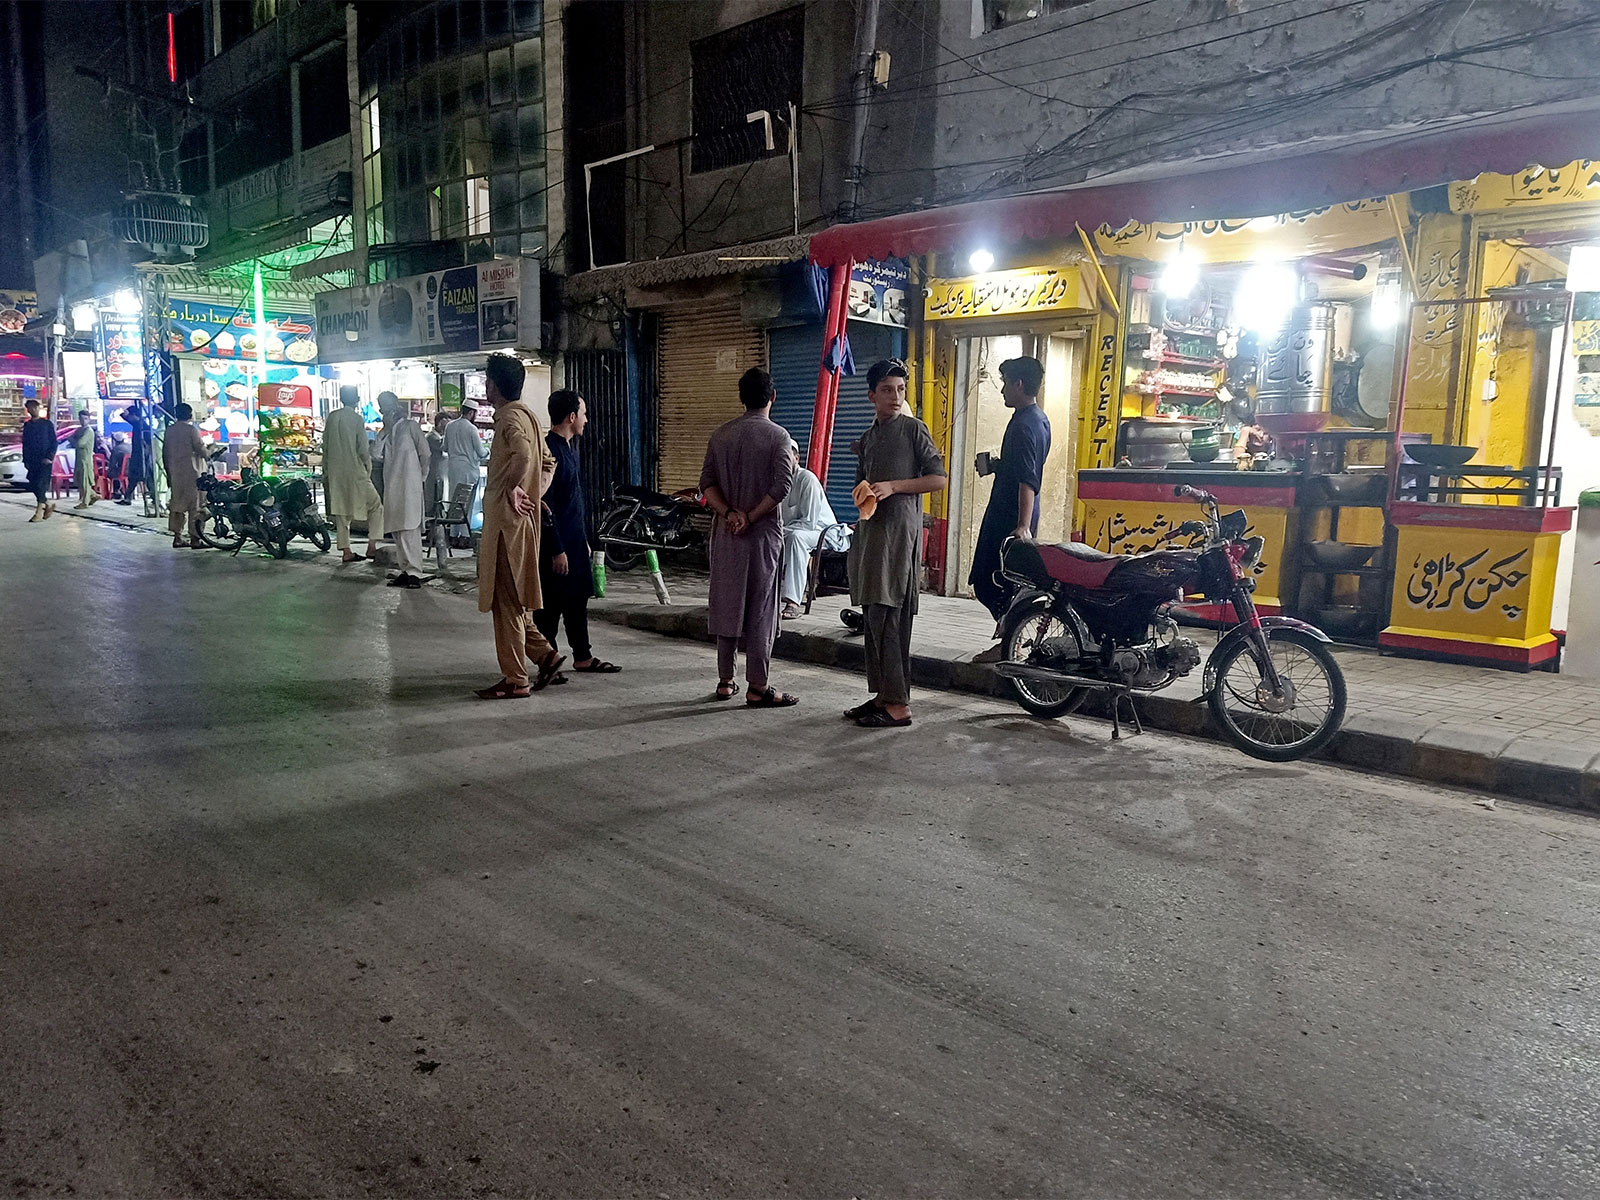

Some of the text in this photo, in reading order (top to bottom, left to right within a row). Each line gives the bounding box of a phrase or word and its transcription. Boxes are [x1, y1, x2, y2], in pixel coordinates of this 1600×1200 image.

[442, 286, 475, 307] FAIZAN
[1406, 552, 1528, 618] چکن کڑاہی
